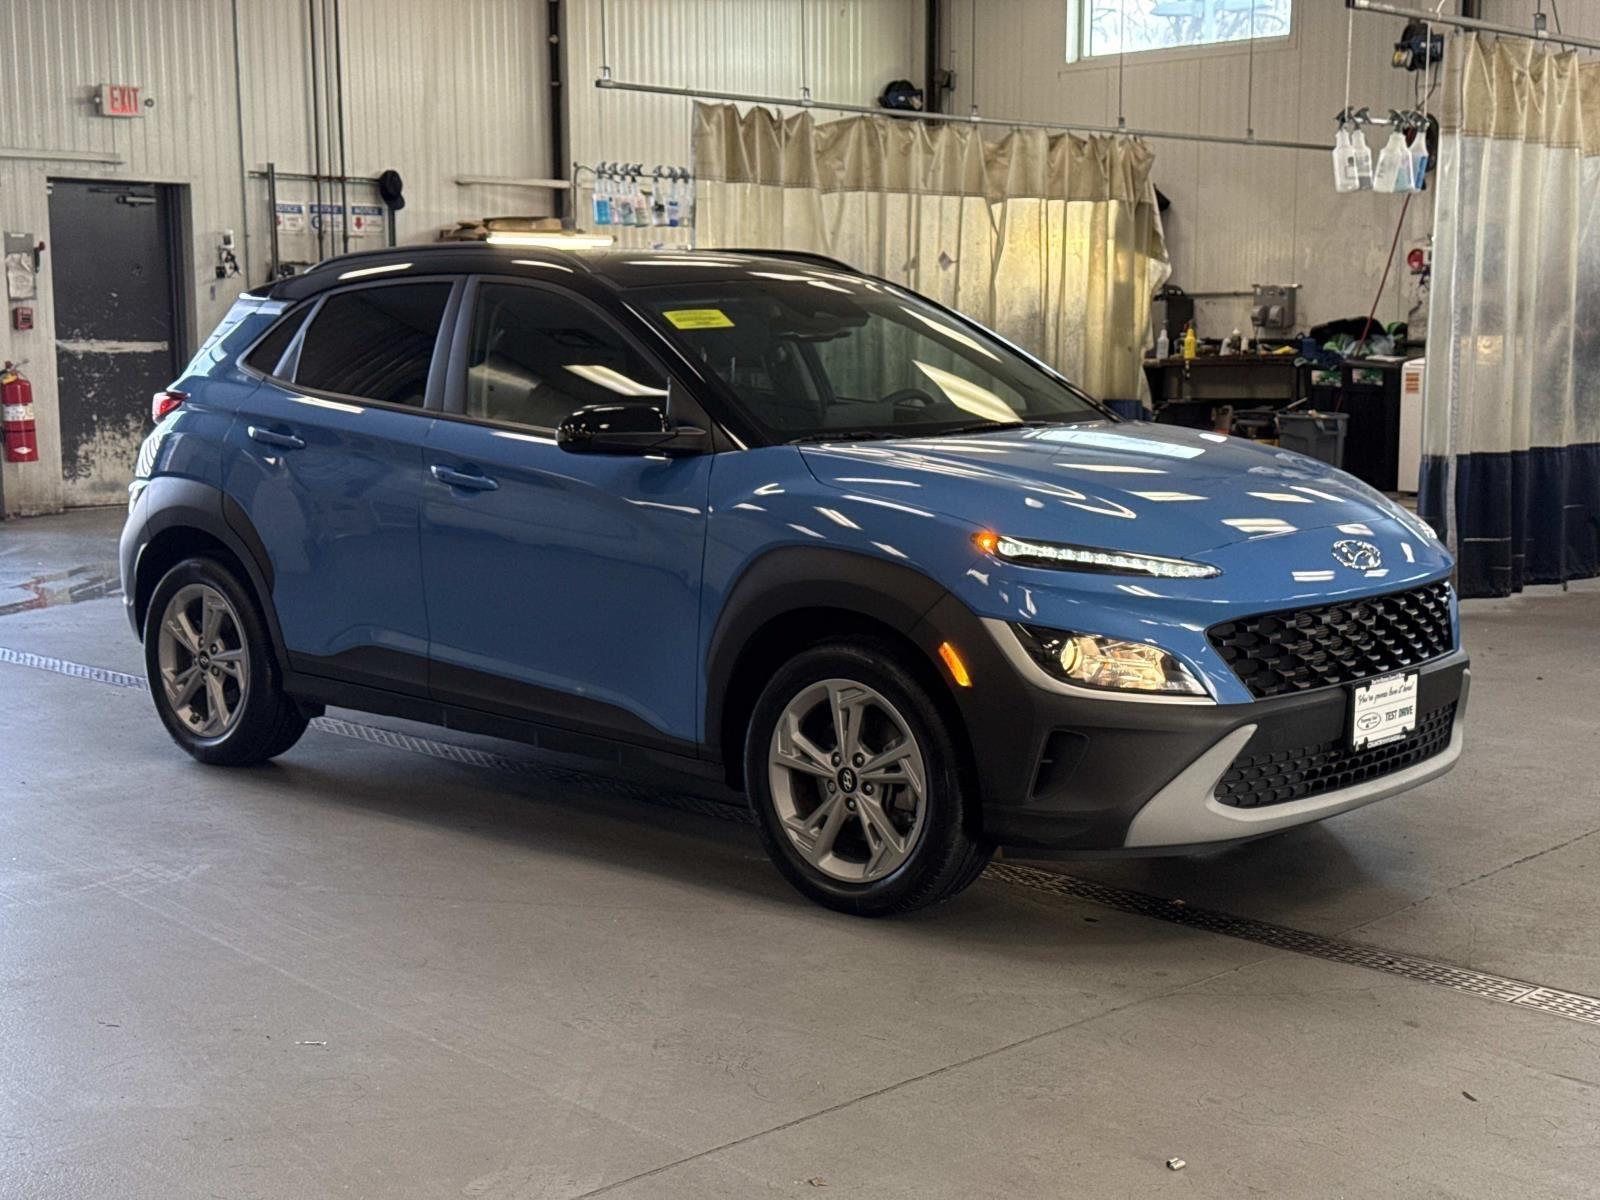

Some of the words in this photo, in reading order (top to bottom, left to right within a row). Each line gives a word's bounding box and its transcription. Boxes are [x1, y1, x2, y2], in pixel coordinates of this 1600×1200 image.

[110, 85, 139, 113] EXIT
[354, 206, 378, 214] NOTICE
[1385, 709, 1398, 721] TEST
[1398, 705, 1414, 718] DRIVE
